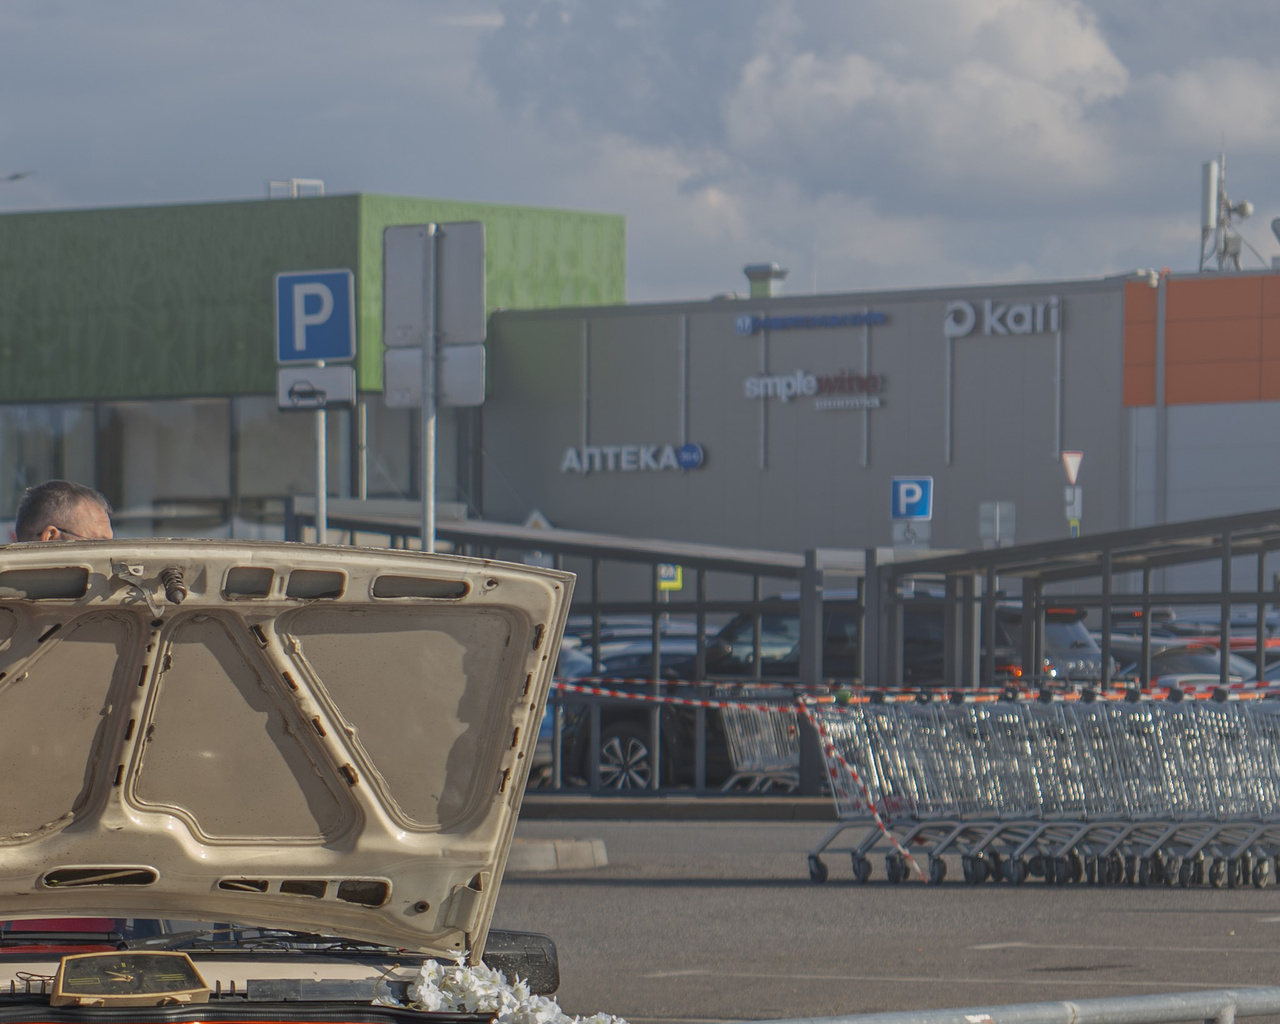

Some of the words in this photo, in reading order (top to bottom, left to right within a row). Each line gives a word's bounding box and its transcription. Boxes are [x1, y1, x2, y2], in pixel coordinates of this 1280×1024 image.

[293, 282, 333, 351] P
[984, 296, 1059, 336] kari
[560, 444, 679, 473] АПТЕКА
[900, 484, 922, 514] P
